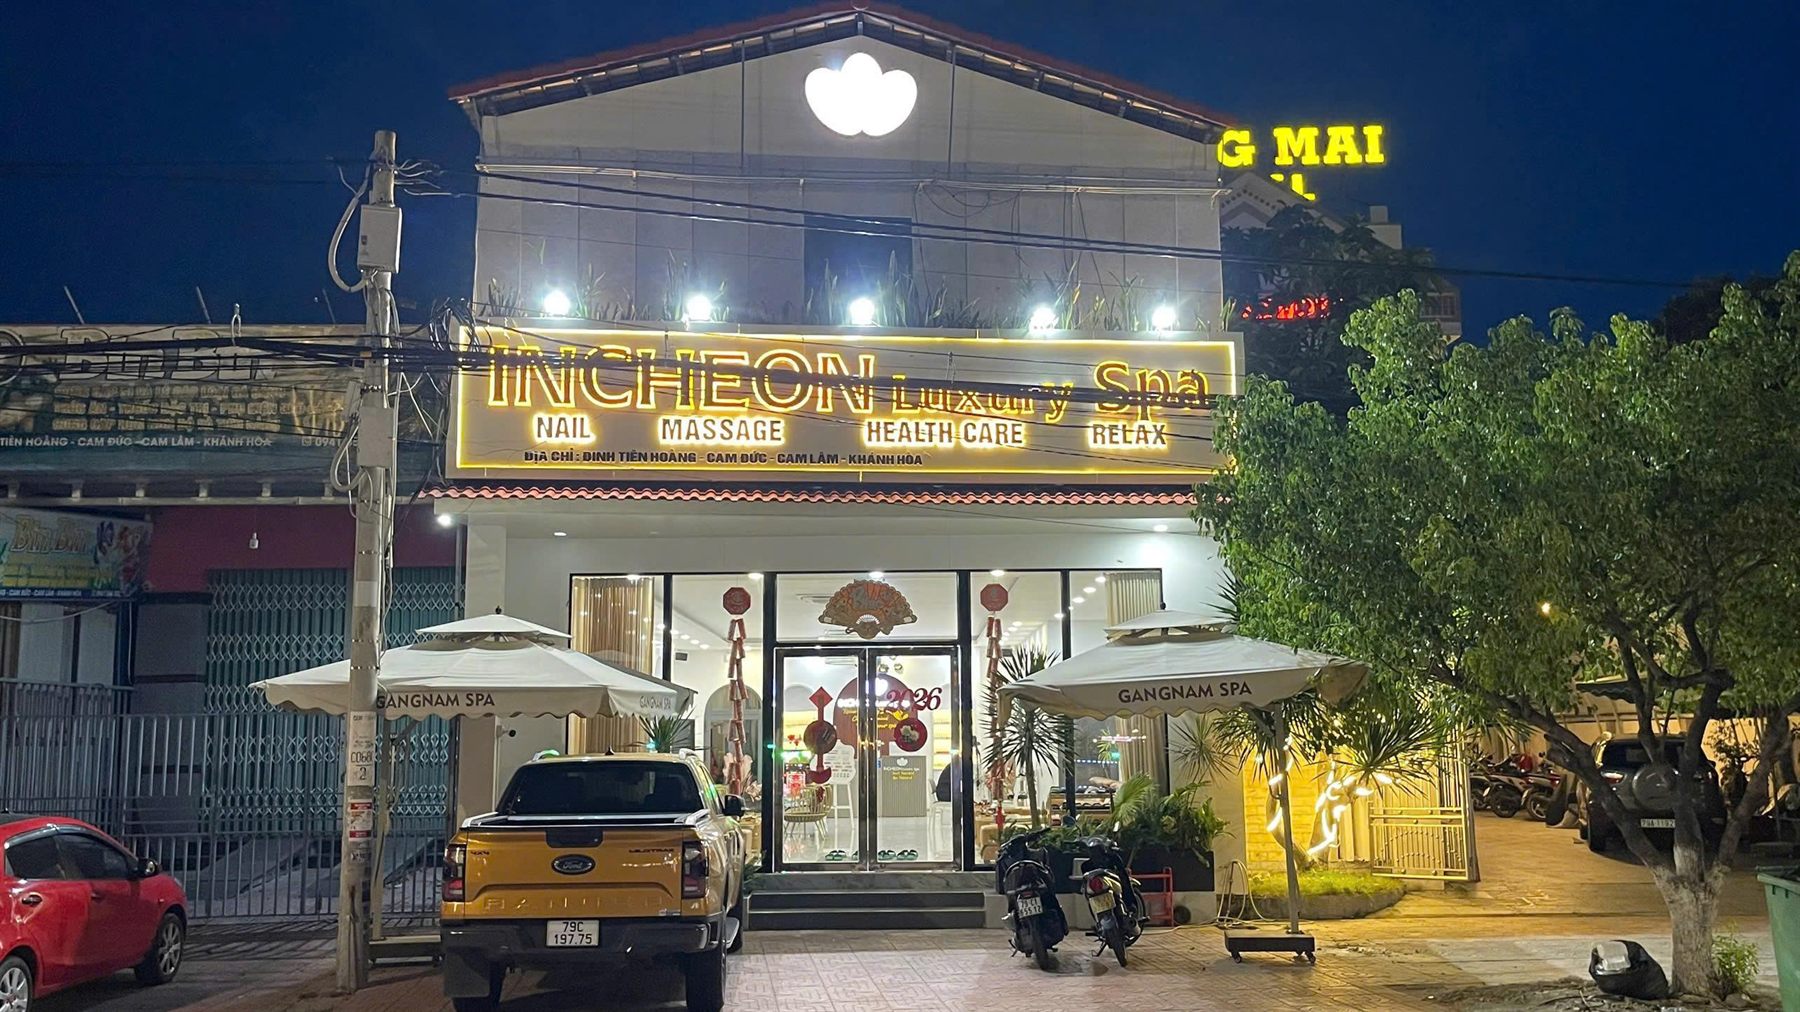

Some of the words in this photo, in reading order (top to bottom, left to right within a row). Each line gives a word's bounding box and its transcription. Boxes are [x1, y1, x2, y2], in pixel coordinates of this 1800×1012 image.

[1273, 125, 1385, 166] MAI
[487, 345, 875, 412] INCHEON
[892, 374, 1073, 423] Luxury
[1095, 360, 1210, 422] Spa
[536, 416, 591, 440] NAIL
[661, 418, 783, 442] MASSAGE
[867, 421, 953, 444] HEALTH
[963, 422, 1023, 445] CARE
[1093, 423, 1167, 445] RELAX
[78, 436, 104, 447] CAM
[618, 449, 648, 462] TIÊN
[650, 449, 697, 463] HOÀNG
[706, 452, 738, 463] CAM
[740, 450, 767, 463] ĐỨC
[777, 453, 807, 464] CAM
[809, 451, 839, 464] LÂM
[848, 451, 896, 465] KHÁNH
[897, 452, 923, 465] HÒA
[376, 692, 460, 710] GANGNAM
[465, 692, 496, 707] SPA
[1117, 683, 1212, 704] GANGNAM
[1220, 681, 1253, 698] SPA
[562, 921, 585, 933] 79C
[553, 934, 593, 945] 197.75
